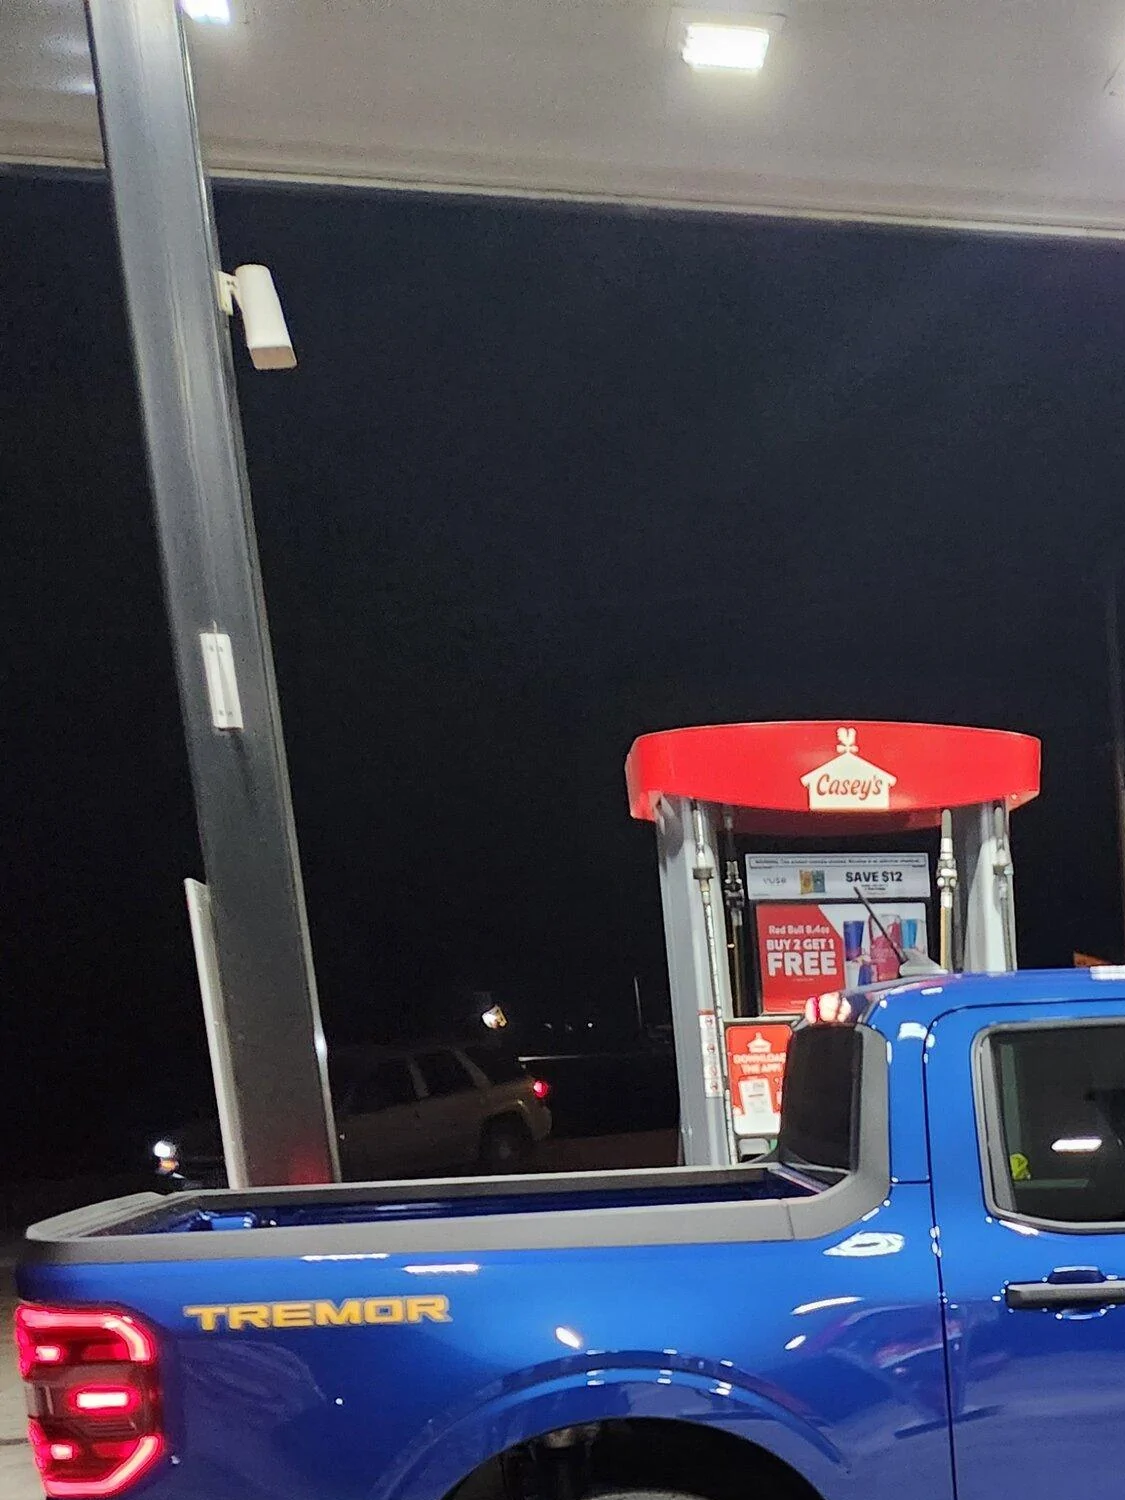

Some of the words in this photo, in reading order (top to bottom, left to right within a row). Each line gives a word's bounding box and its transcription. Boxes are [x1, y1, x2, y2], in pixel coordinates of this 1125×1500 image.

[816, 774, 883, 801] Casey's
[845, 871, 882, 883] SAVE
[883, 870, 903, 882] $12
[768, 925, 786, 935] Red
[787, 925, 804, 934] Bull
[766, 939, 791, 951] BUY
[793, 938, 801, 950] 2
[802, 938, 827, 950] GET
[828, 938, 834, 949] 1
[767, 951, 837, 976] FREE
[183, 1295, 453, 1333] TREMOR
